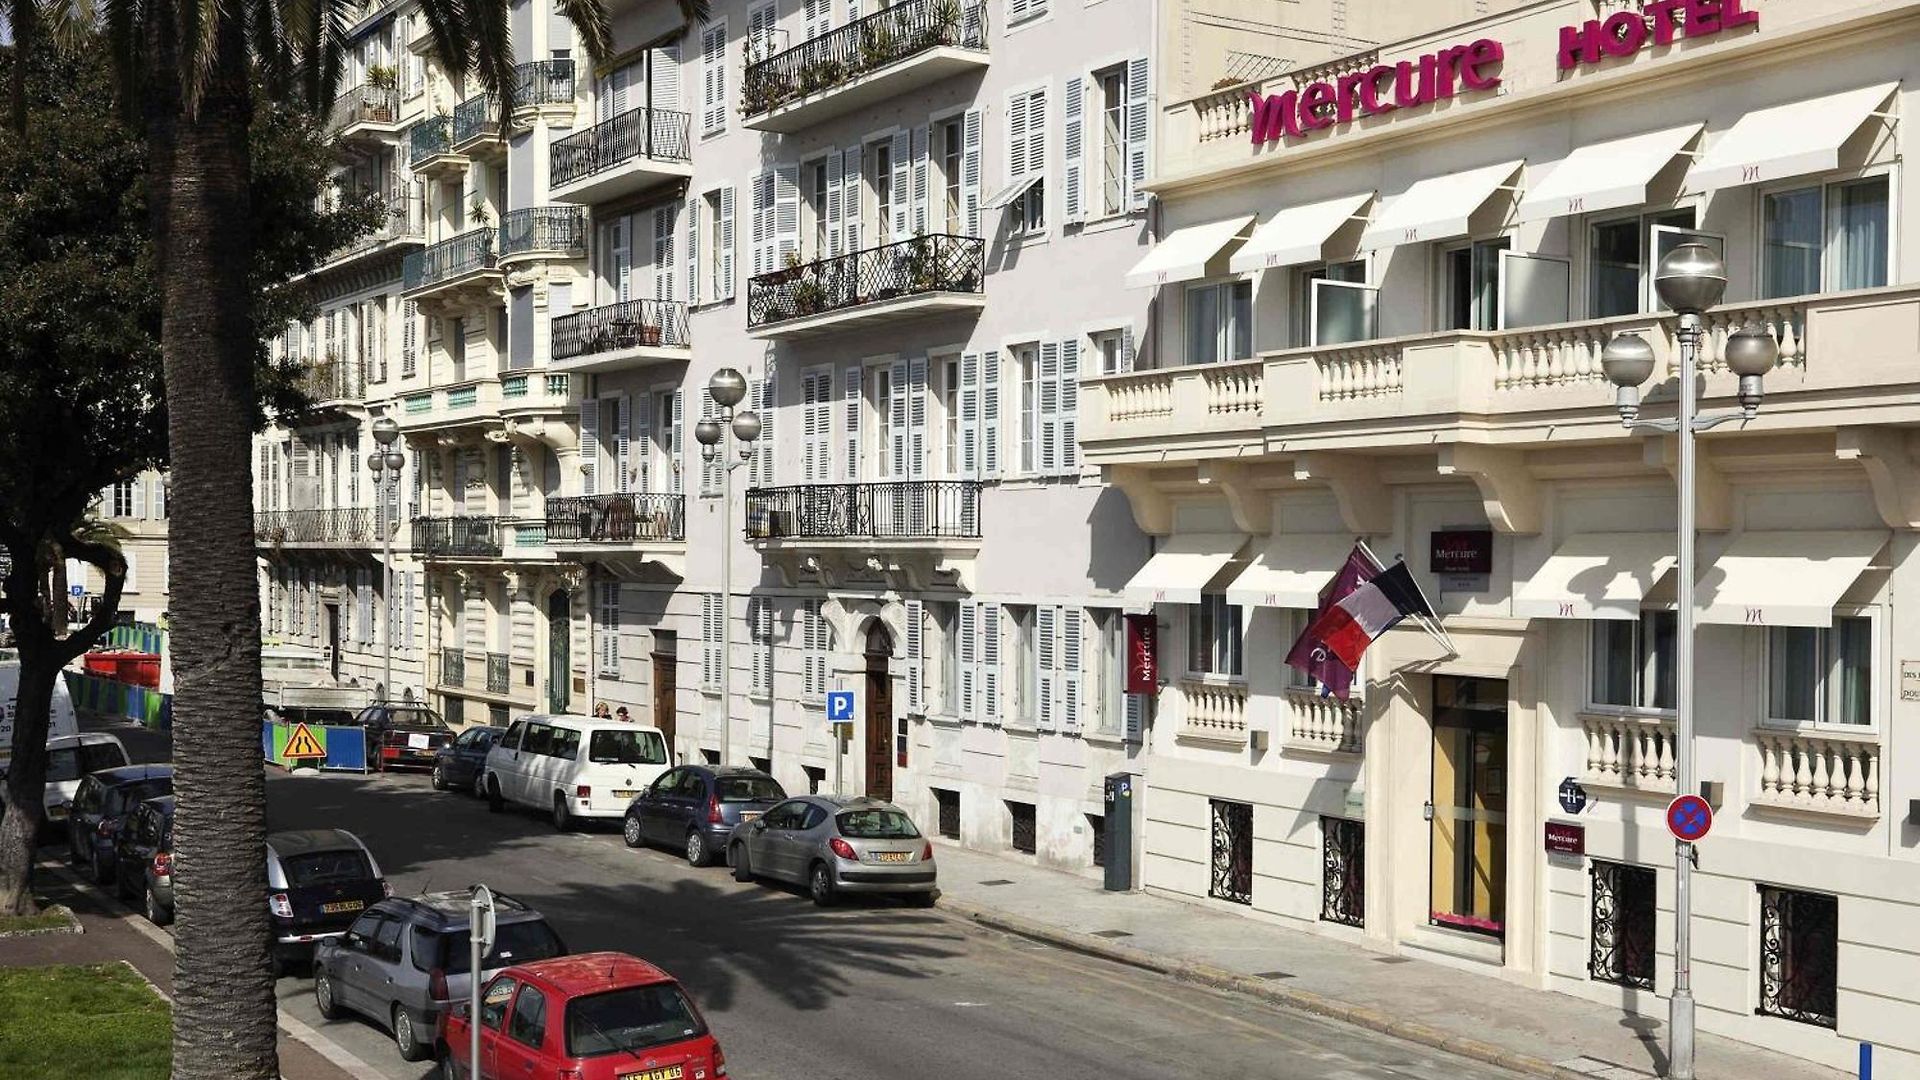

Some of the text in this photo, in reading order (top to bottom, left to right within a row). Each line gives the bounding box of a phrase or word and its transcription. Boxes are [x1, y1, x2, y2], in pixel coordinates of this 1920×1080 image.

[1559, 0, 1760, 70] HOTEL
[834, 696, 847, 716] P
[1548, 833, 1578, 845] Mercure
